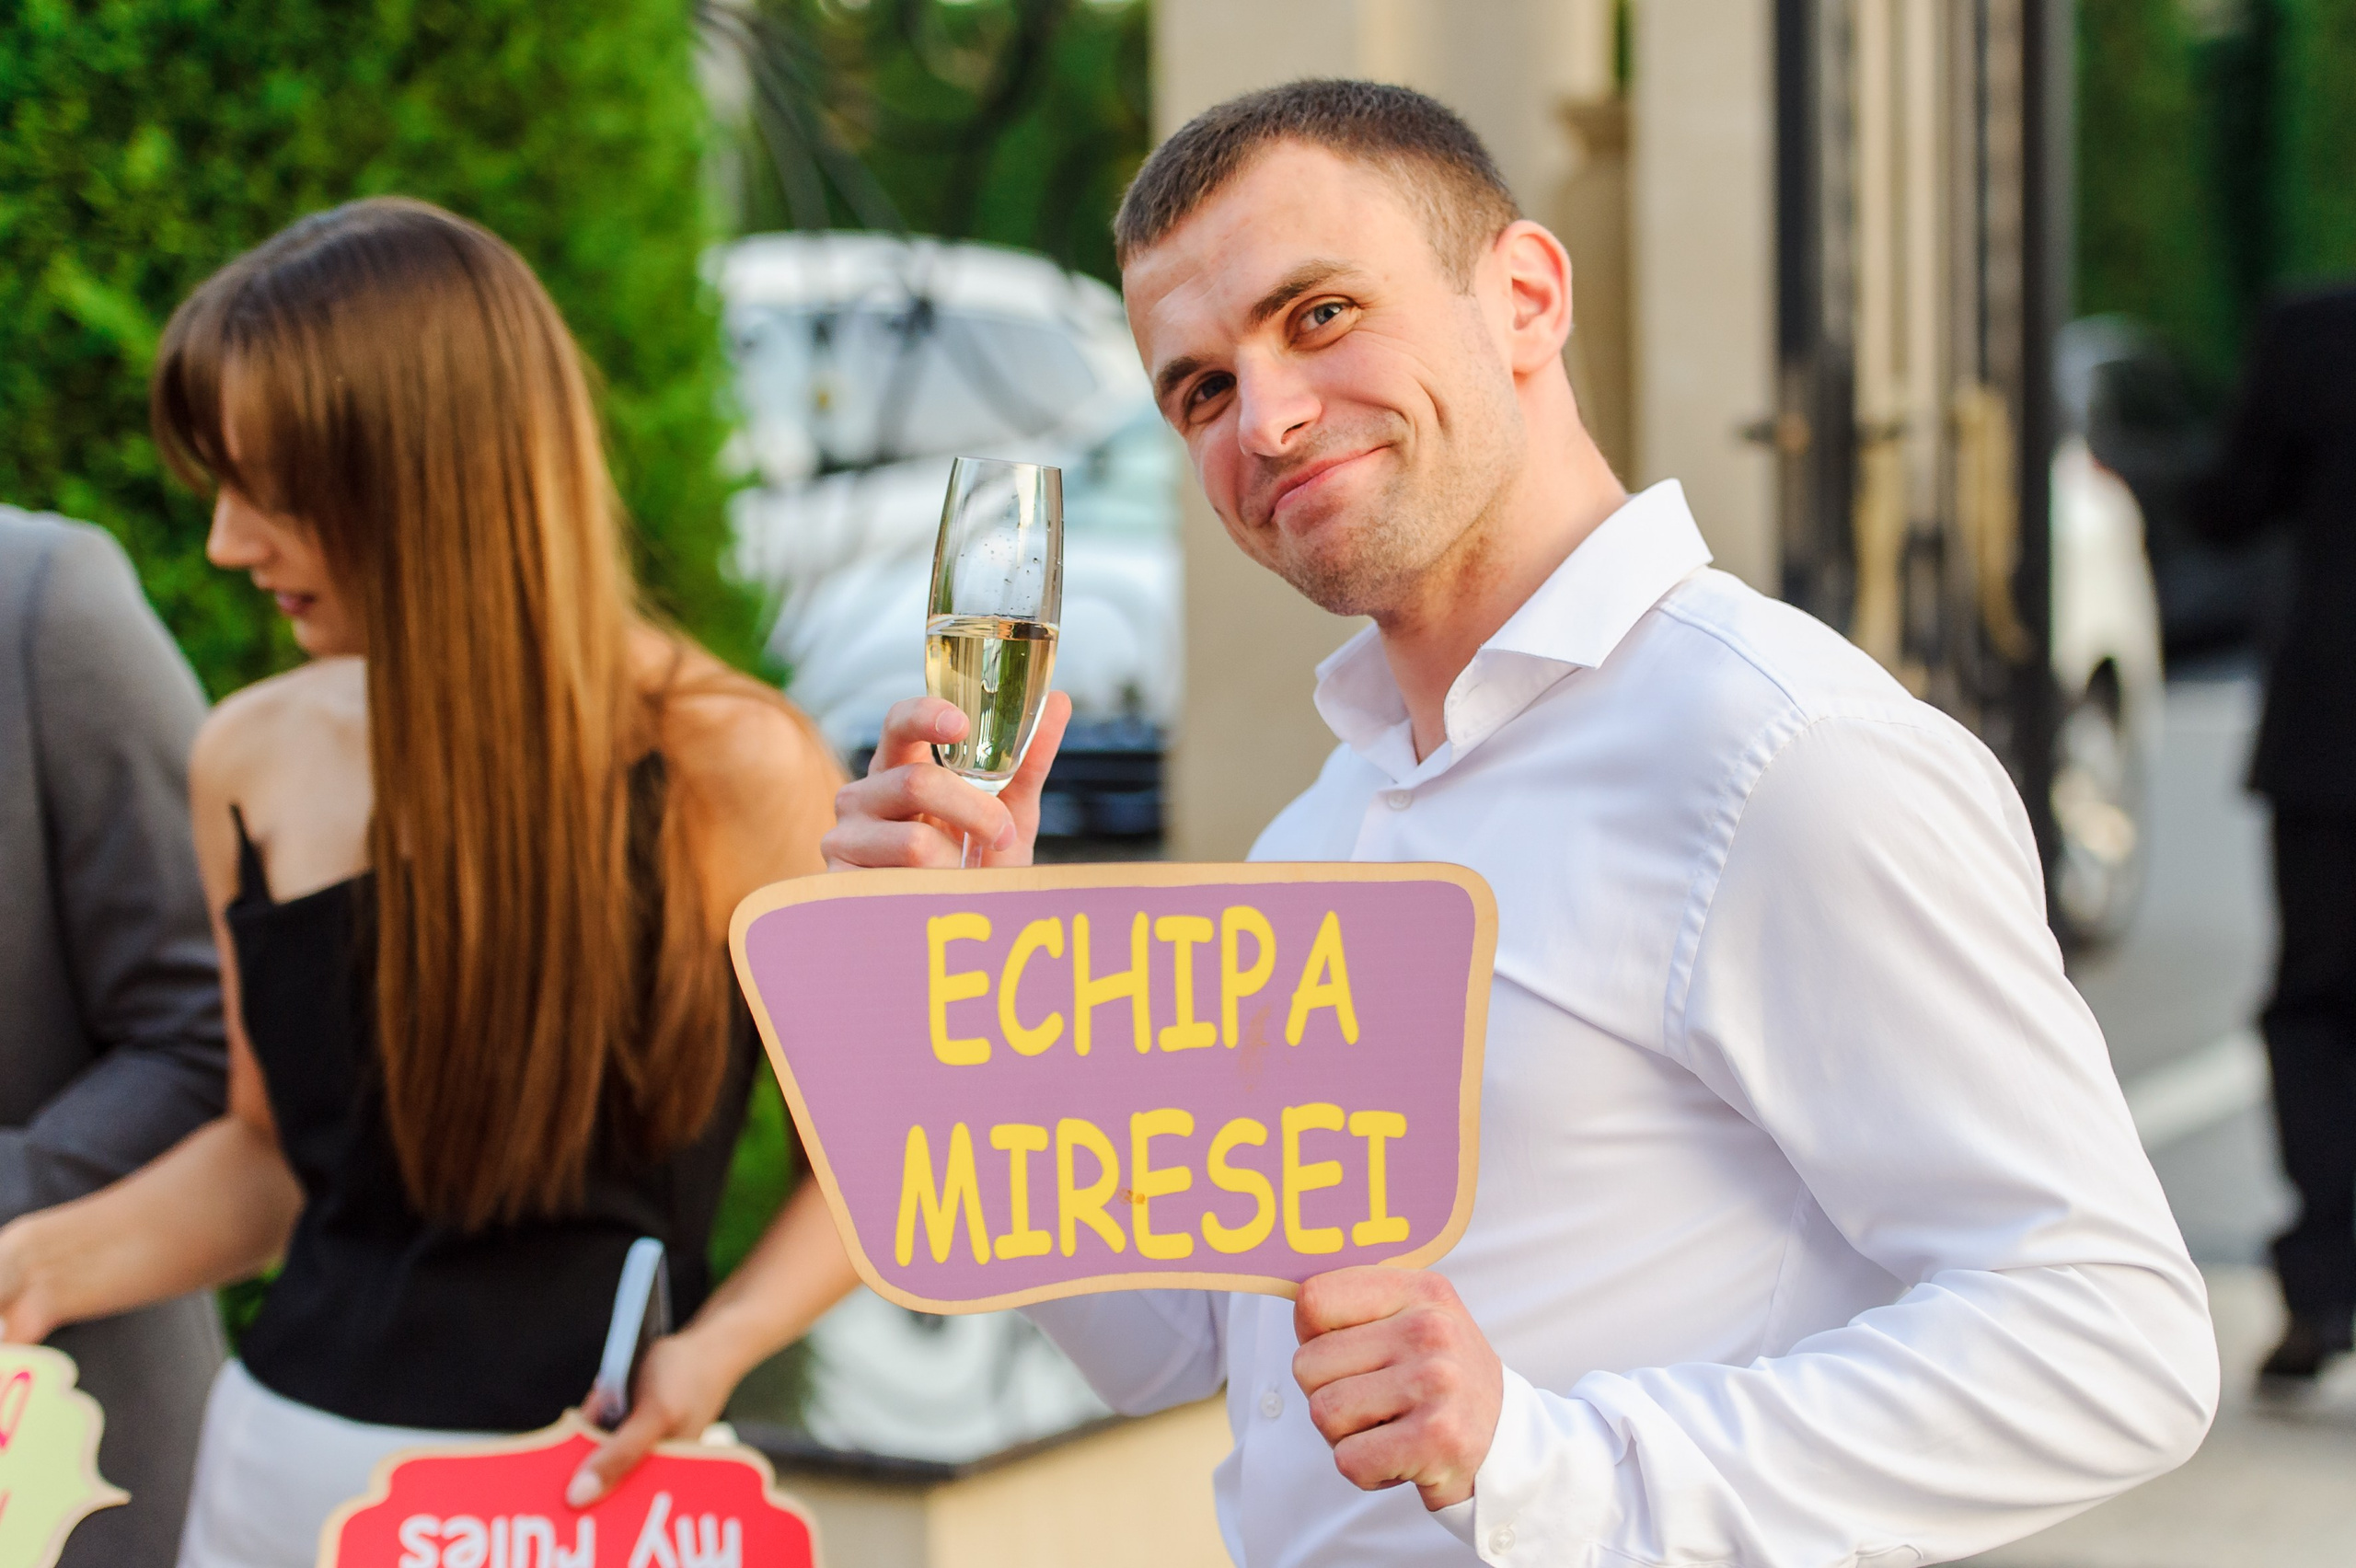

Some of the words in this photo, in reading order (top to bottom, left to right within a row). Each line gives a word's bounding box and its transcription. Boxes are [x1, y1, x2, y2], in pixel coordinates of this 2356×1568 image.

[926, 905, 1360, 1066] ECHIPA
[894, 1102, 1411, 1267] MIRESEI
[628, 1490, 743, 1568] my
